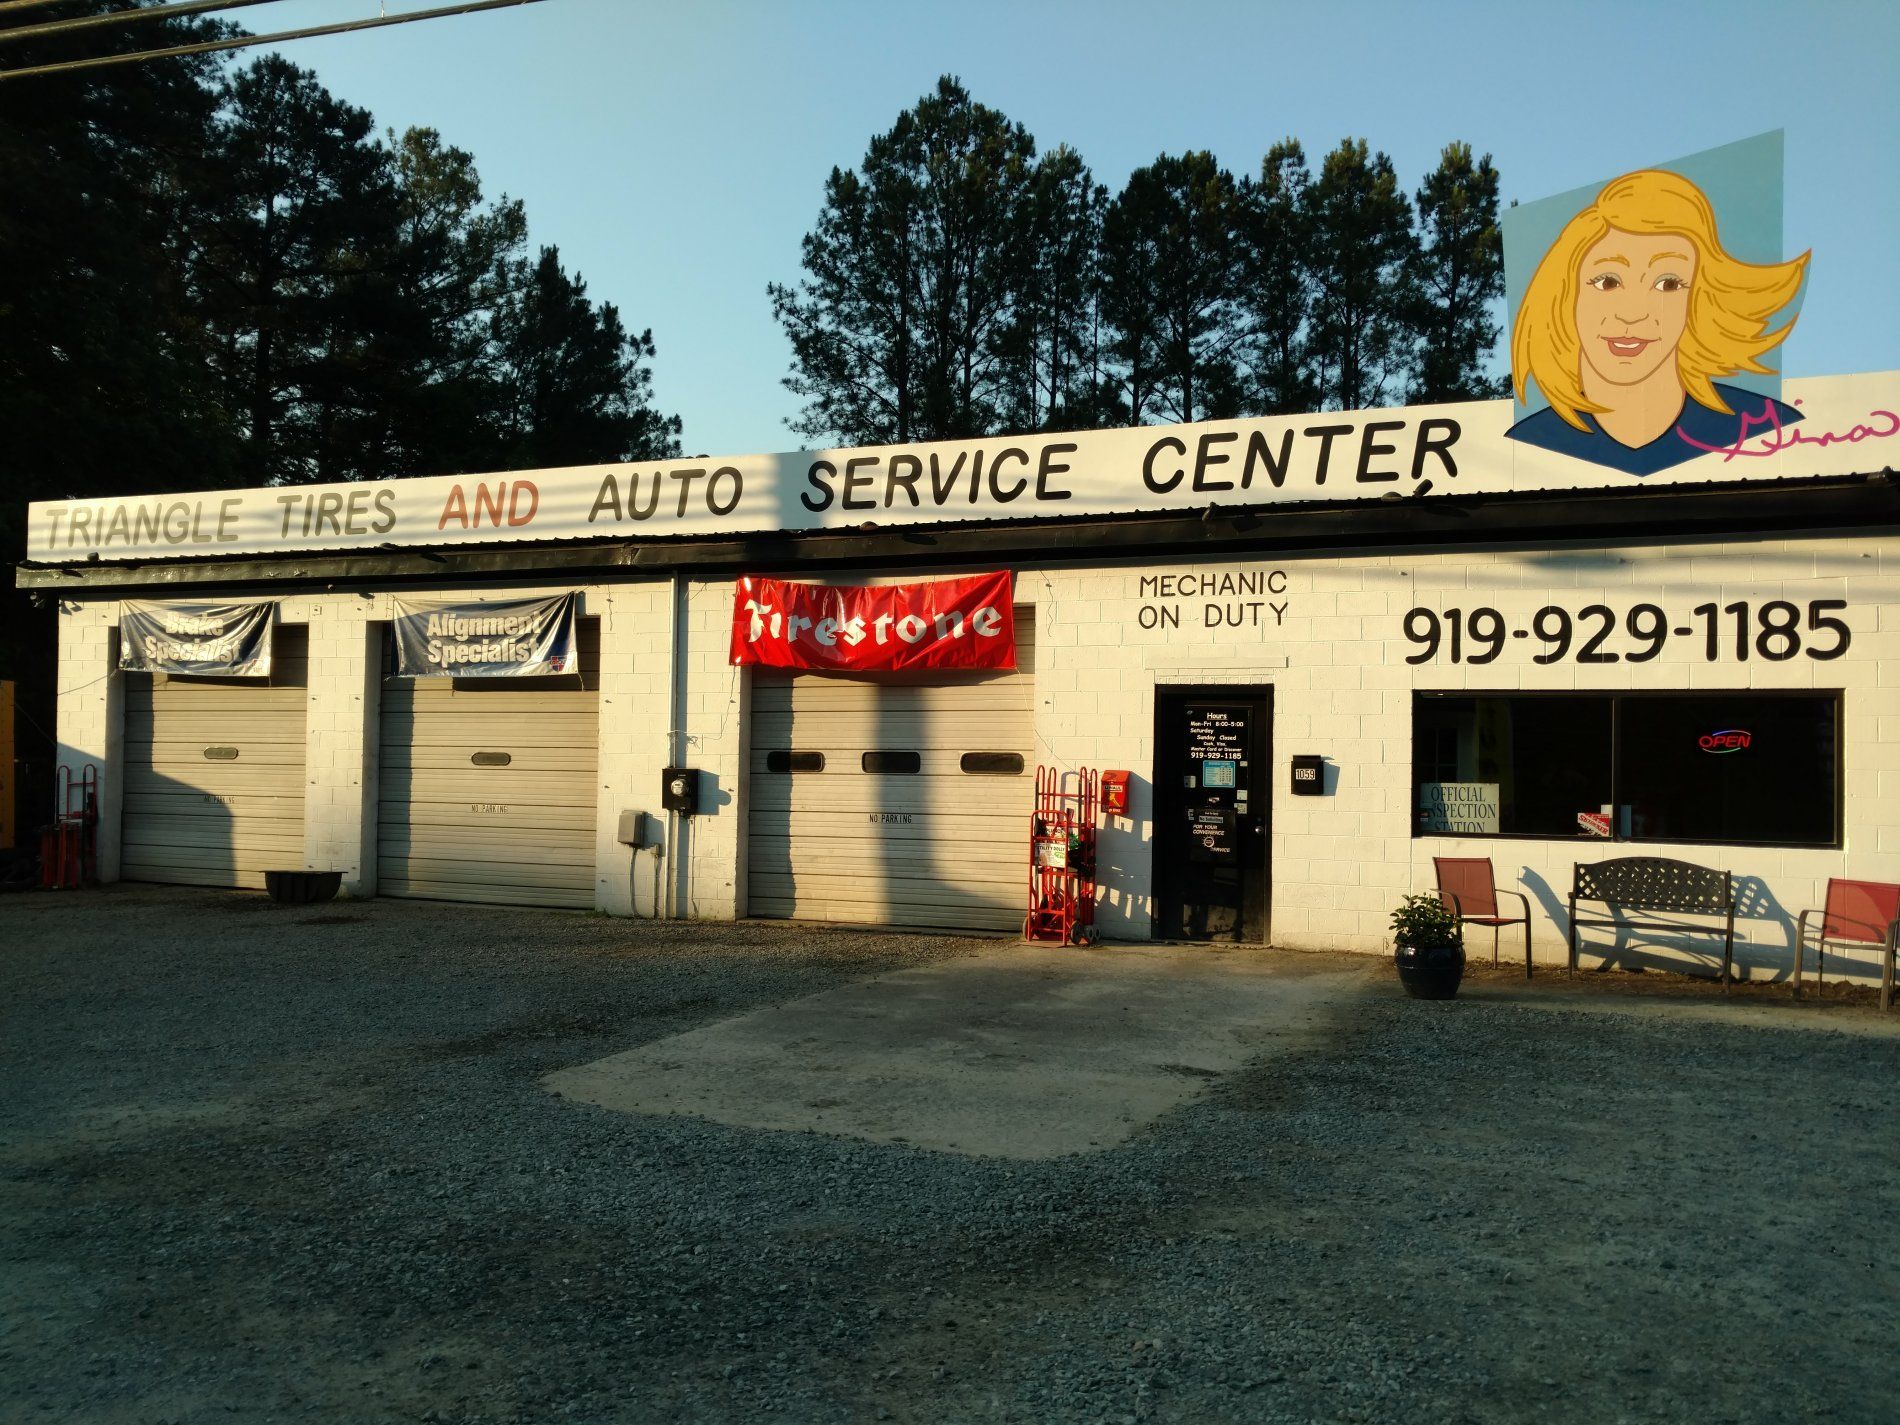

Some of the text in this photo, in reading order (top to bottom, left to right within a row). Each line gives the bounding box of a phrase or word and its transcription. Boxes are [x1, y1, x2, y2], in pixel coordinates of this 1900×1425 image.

[1677, 398, 1900, 463] Gina
[46, 418, 1462, 549] TRIANGLE TIRES AND AUTO SERVICE CENTER
[1139, 570, 1288, 598] MECHANIC
[165, 611, 224, 636] Brake
[426, 610, 543, 642] Alignment
[743, 598, 1003, 647] Firestone
[1138, 602, 1289, 629] ON DUTY
[1402, 599, 1852, 665] 919-929-1185
[145, 635, 241, 665] Specialist
[427, 637, 540, 668] Specialist
[1206, 712, 1227, 720] Hours
[1699, 735, 1751, 748] OPEN
[1190, 752, 1242, 760] 919-929-1185
[1296, 769, 1315, 780] 1059
[1431, 786, 1486, 802] OFFICIAL
[869, 813, 912, 824] NO PARKING
[1435, 821, 1485, 833] STATION
